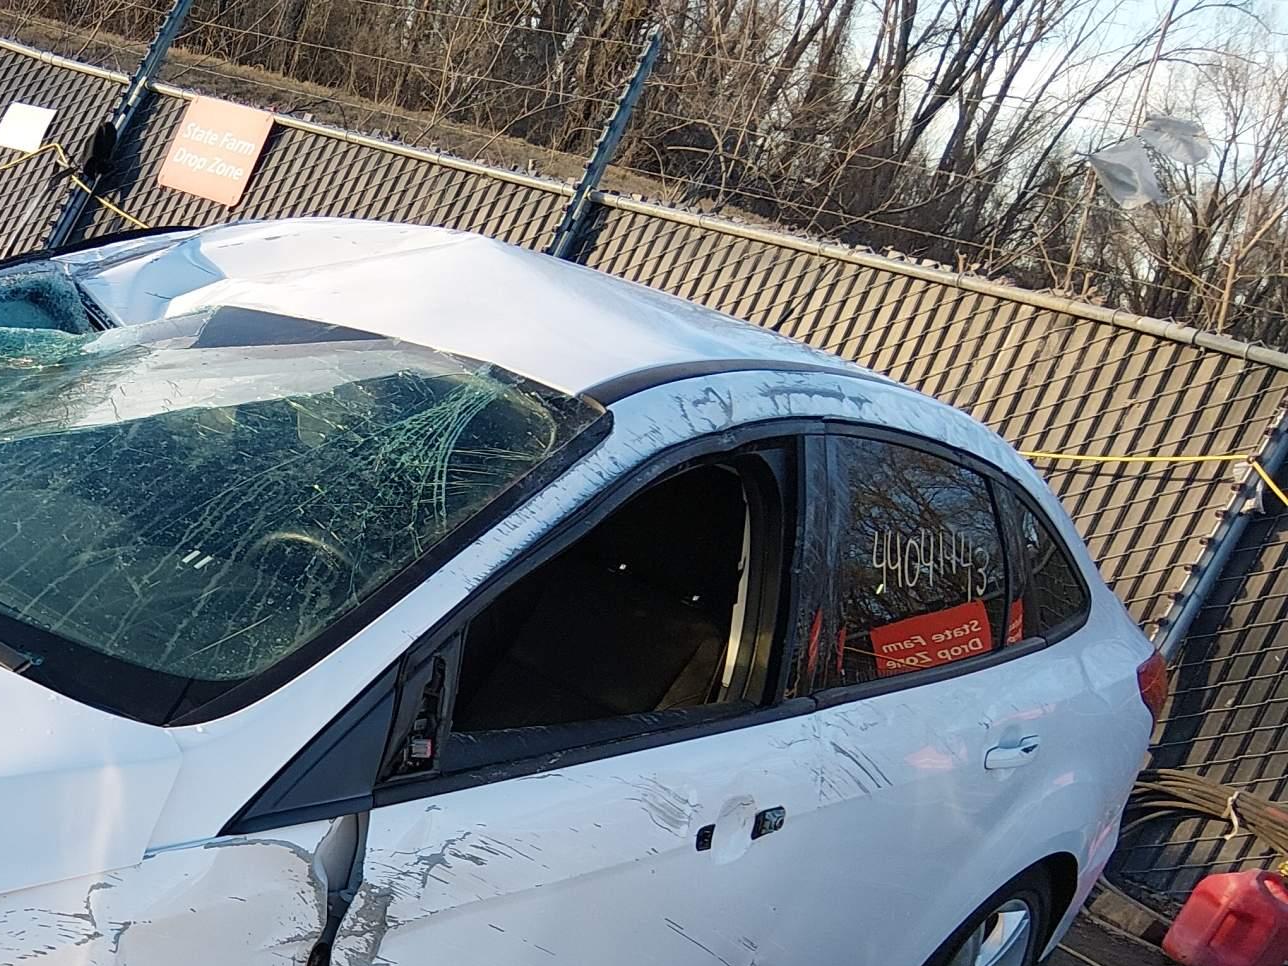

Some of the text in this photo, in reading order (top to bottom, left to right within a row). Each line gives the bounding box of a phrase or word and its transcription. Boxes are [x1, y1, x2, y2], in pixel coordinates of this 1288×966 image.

[184, 123, 255, 155] State Farm
[174, 148, 244, 180] Drop Zone
[872, 527, 990, 602] 44041443
